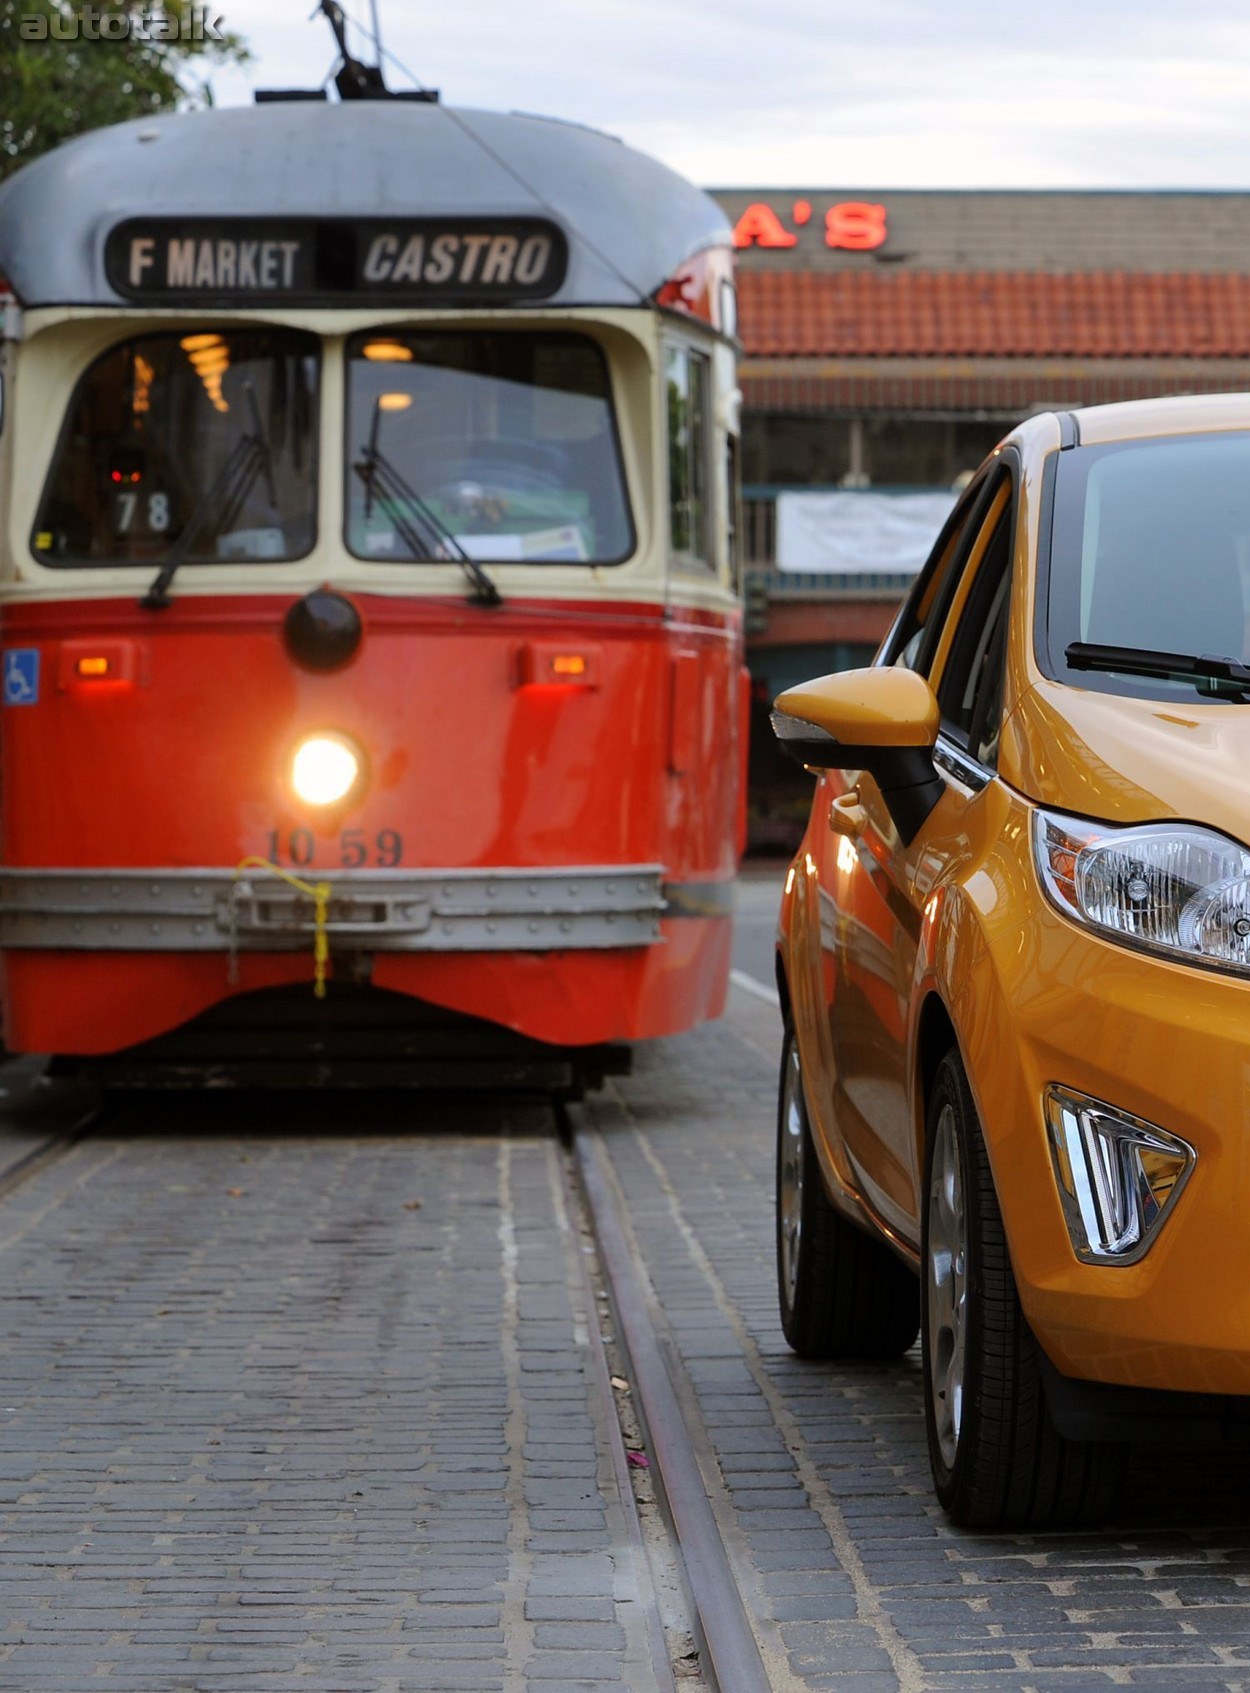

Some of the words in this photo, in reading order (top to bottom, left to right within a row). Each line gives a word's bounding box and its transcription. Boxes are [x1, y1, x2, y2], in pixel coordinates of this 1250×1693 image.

[129, 238, 156, 287] F
[166, 238, 299, 290] MARKET
[362, 234, 551, 286] CASTRO
